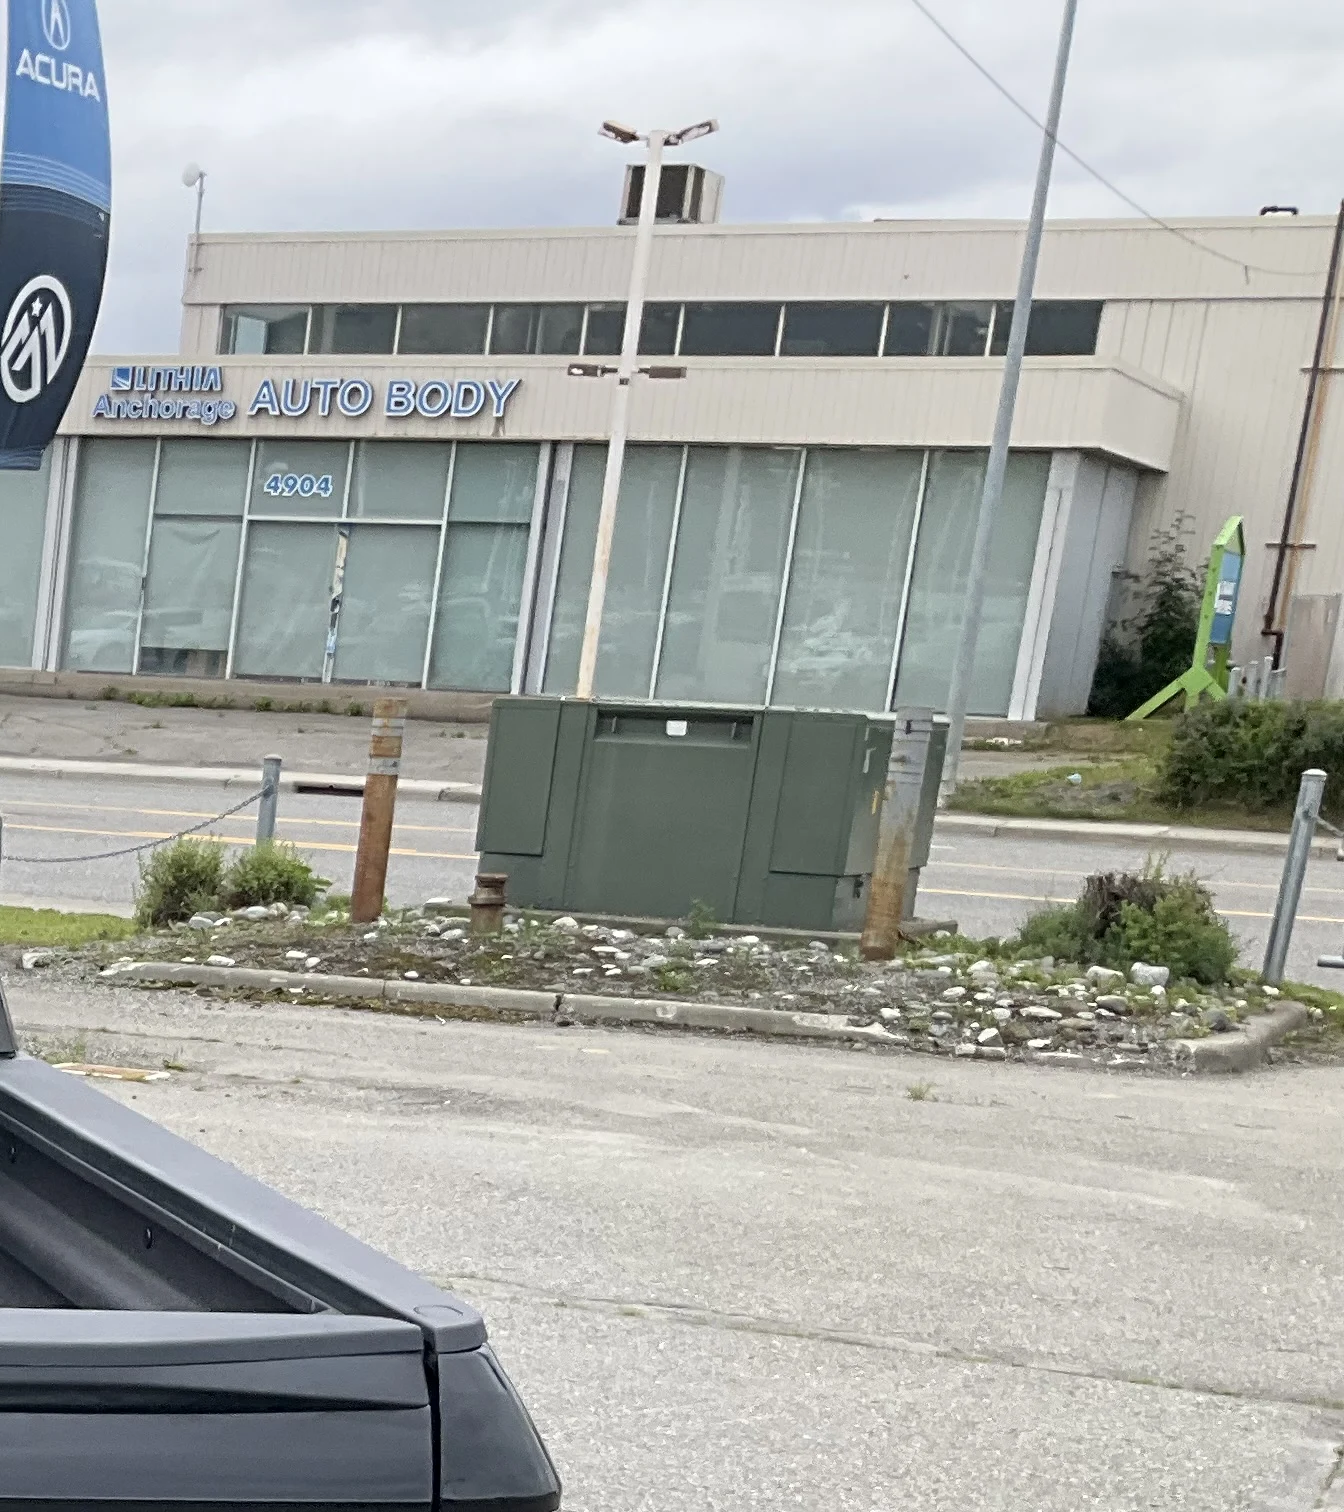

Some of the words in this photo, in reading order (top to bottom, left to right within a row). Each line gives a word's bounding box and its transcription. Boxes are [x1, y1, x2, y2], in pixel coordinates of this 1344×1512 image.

[15, 48, 101, 103] ACURA
[133, 367, 222, 391] LITHIA
[92, 393, 237, 426] Anchorage
[247, 378, 373, 418] AUTO
[383, 378, 520, 419] BODY
[263, 474, 333, 498] 4904
